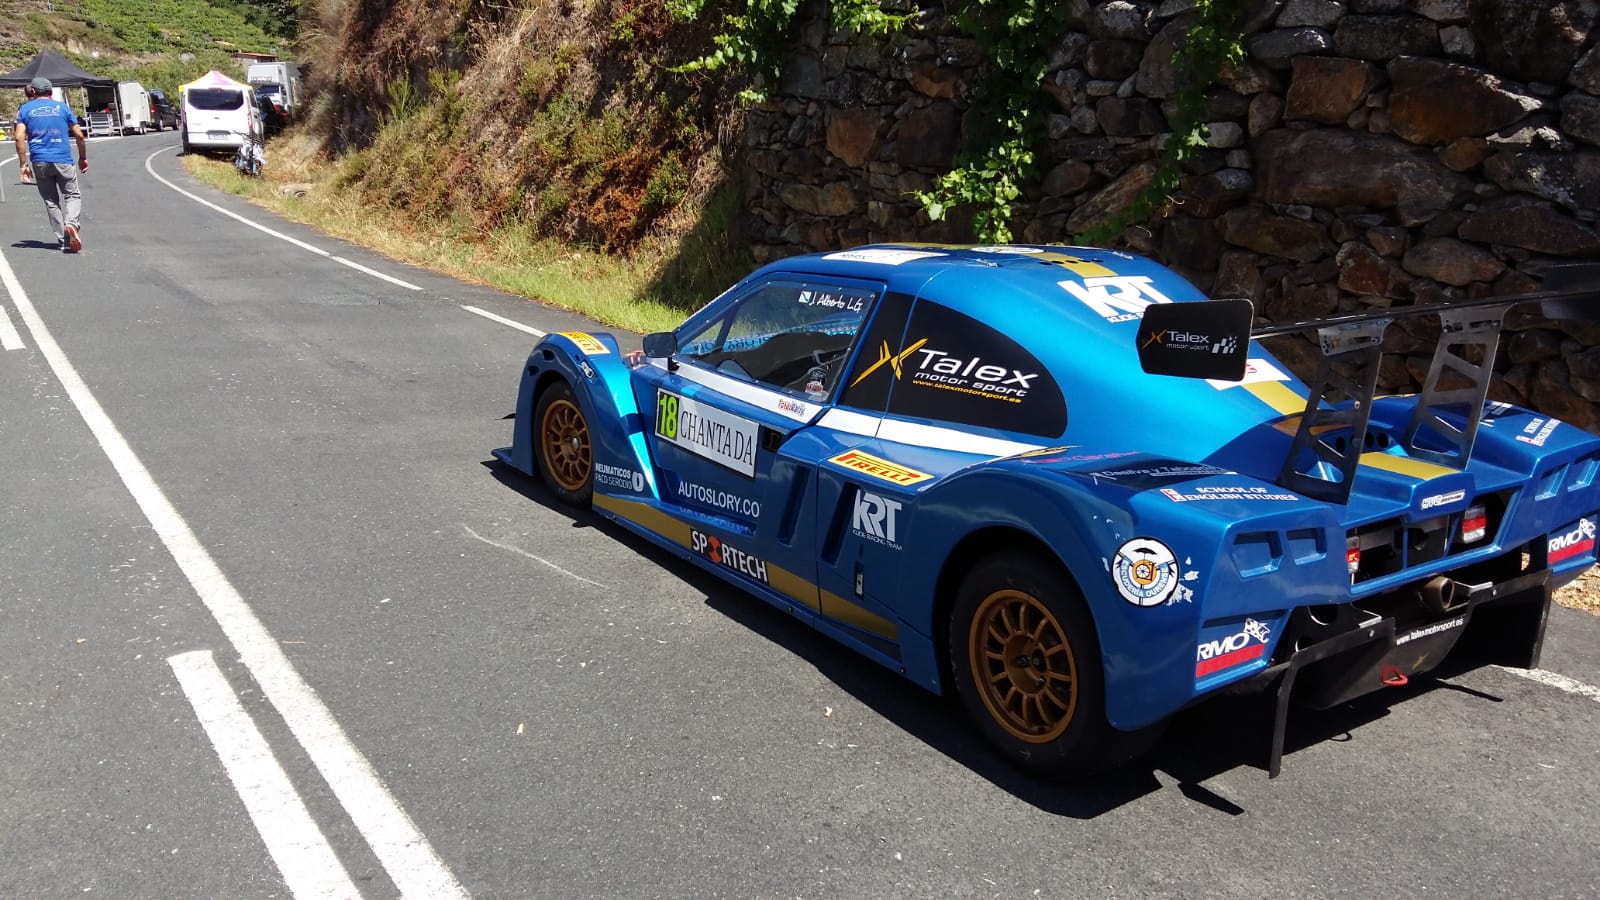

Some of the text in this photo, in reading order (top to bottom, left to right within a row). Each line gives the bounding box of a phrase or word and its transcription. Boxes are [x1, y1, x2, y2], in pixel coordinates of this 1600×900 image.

[816, 293, 846, 309] Alberto
[1056, 275, 1174, 318] KRT
[1167, 330, 1210, 343] Talex
[918, 348, 1039, 389] Talex
[912, 379, 1022, 404] www.talexmotorsport.es
[914, 372, 1028, 398] motor sport
[660, 394, 678, 439] 18
[680, 410, 753, 467] CHANTADA
[595, 462, 631, 479] NEUMATICOS
[835, 452, 921, 483] PIRELLI
[678, 480, 762, 518] AUTOSLORY.CO
[853, 489, 902, 542] KRT
[1548, 529, 1582, 553] RMO
[1145, 564, 1170, 598] OURENSE
[1197, 632, 1251, 662] RMO
